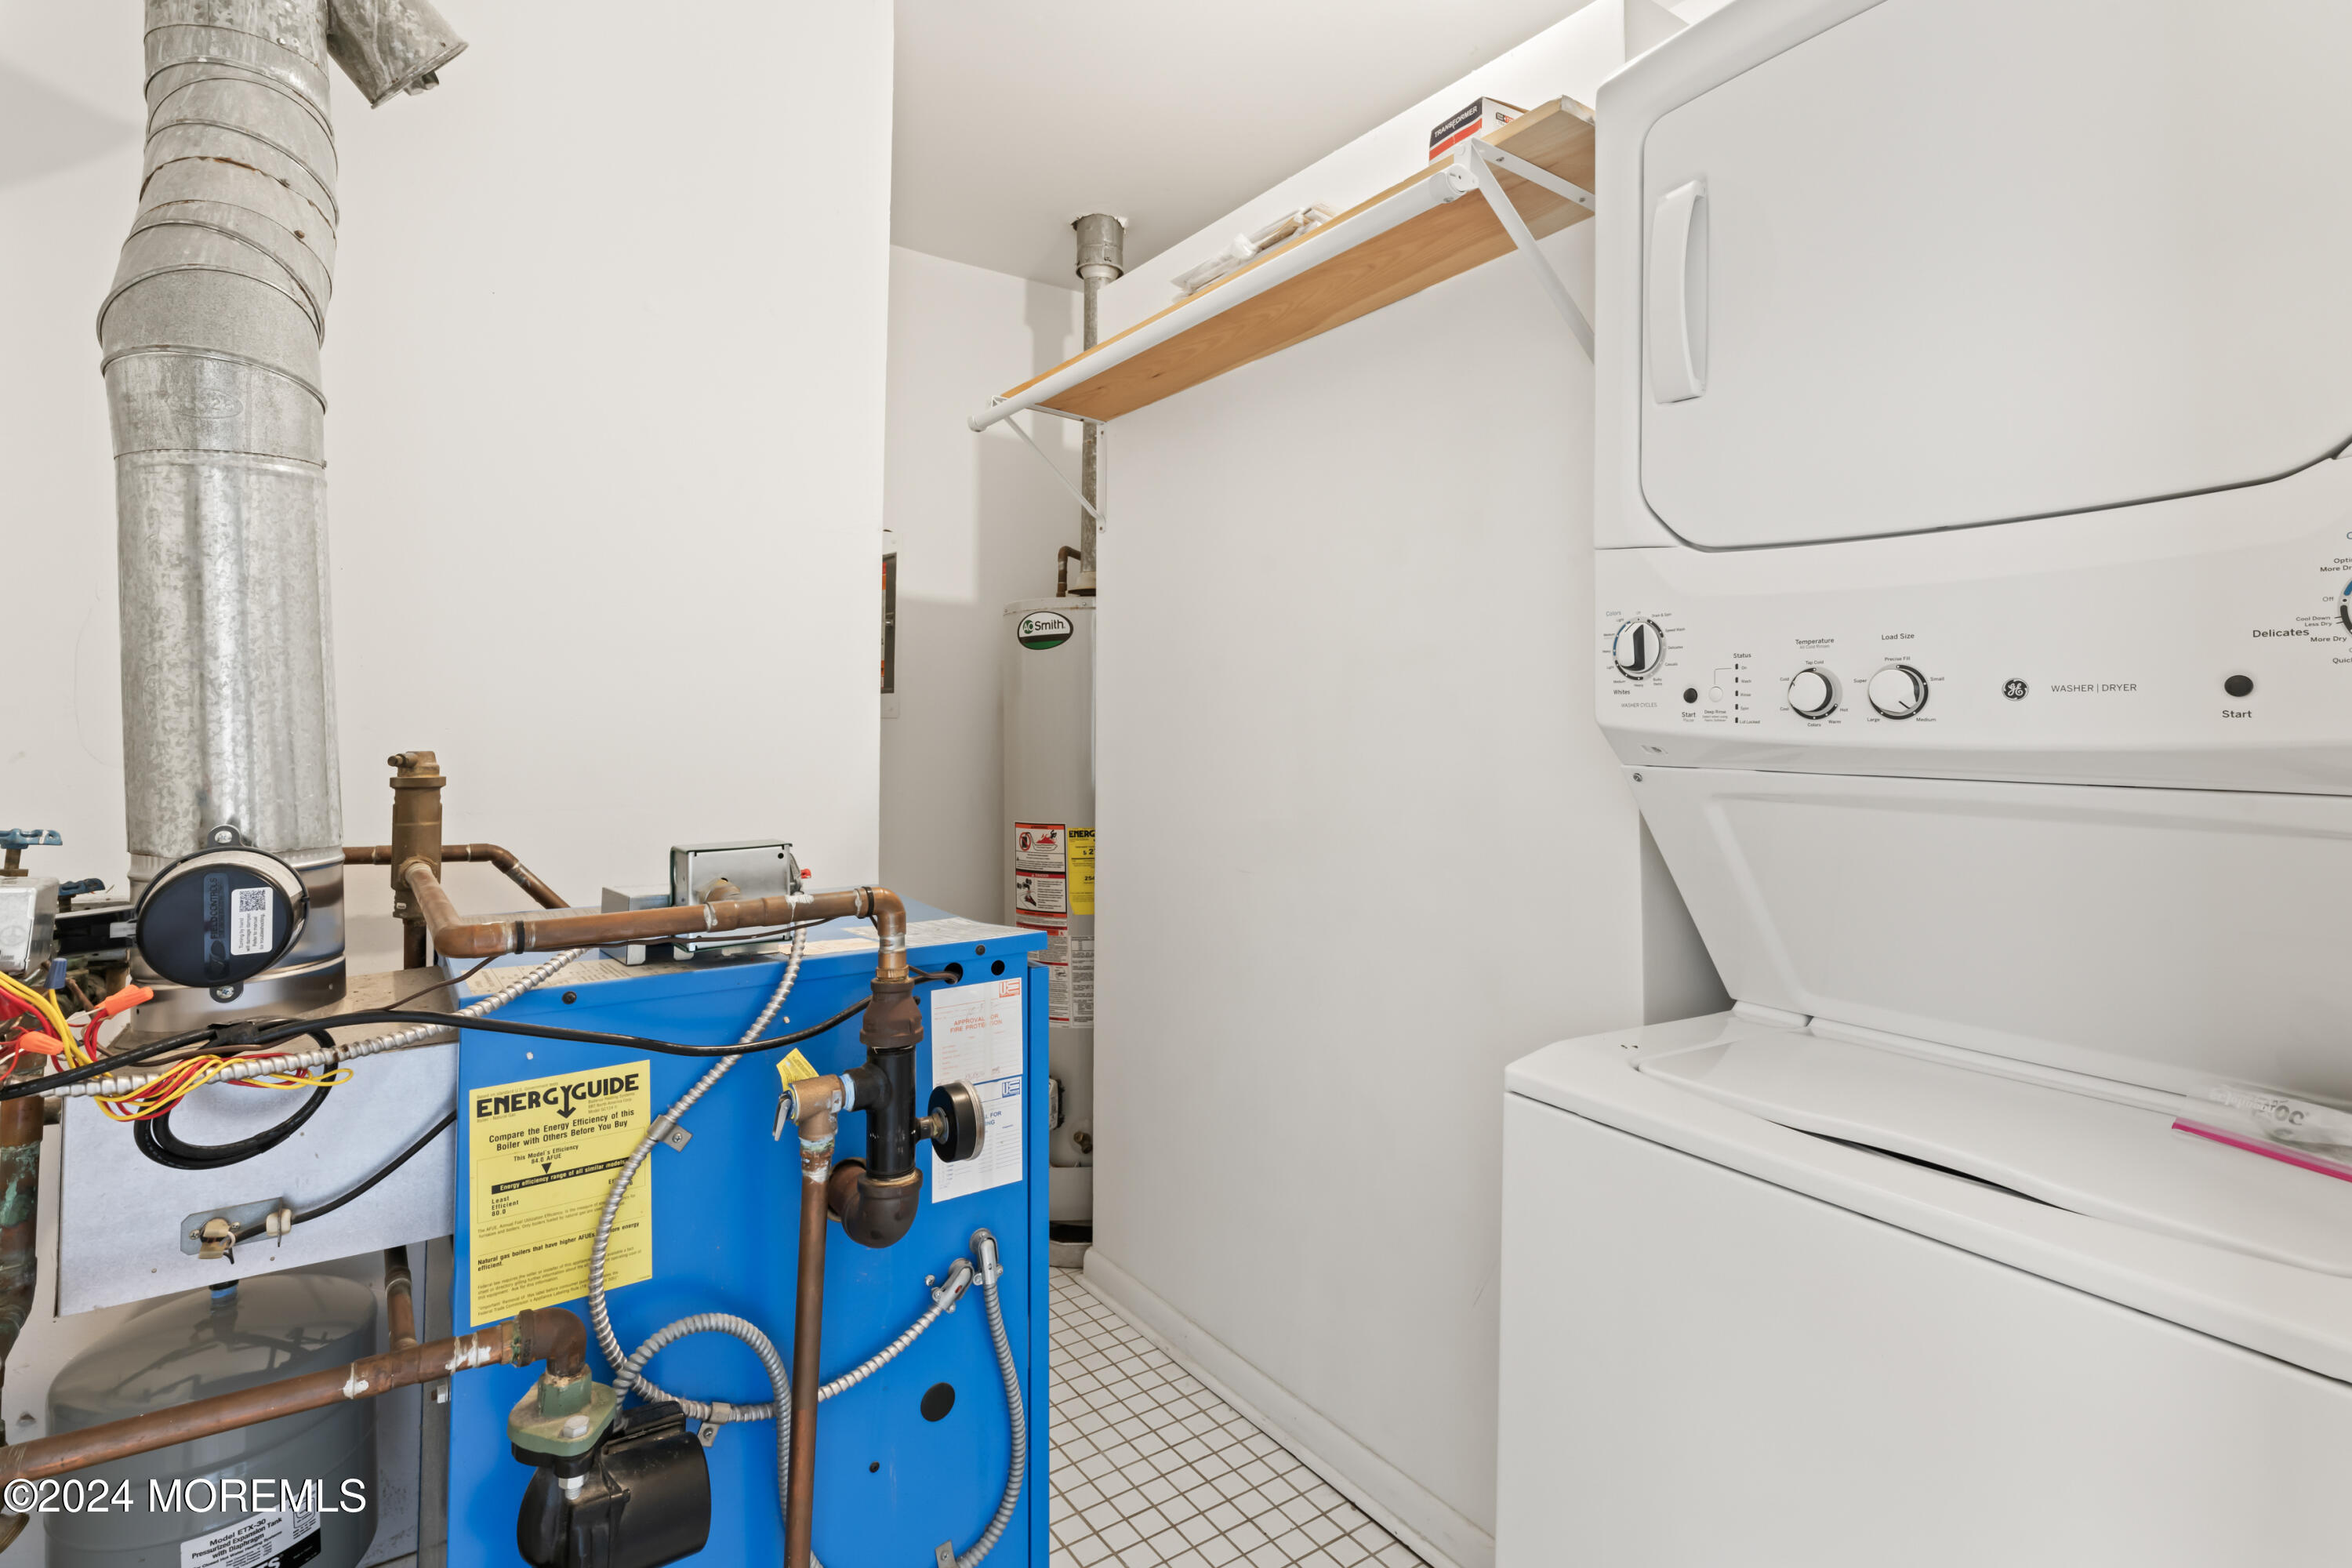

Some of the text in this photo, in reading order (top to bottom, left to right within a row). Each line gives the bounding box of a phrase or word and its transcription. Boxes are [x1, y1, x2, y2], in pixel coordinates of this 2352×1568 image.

[1434, 105, 1478, 138] TRANSFORMER
[1034, 619, 1064, 631] Smith
[2252, 628, 2310, 638] Delicates
[2051, 683, 2137, 693] WASHER DRYER
[2222, 710, 2252, 719] Start
[1069, 829, 1095, 838] ENERG
[950, 1021, 1003, 1034] FIRE PROTEION
[953, 1016, 985, 1026] APPROVAL
[477, 1073, 639, 1119] ENERGYGUIDE
[989, 1110, 1002, 1119] FOR
[489, 1129, 524, 1144] Compare
[528, 1126, 539, 1135] the
[543, 1120, 568, 1133] Energy
[572, 1113, 608, 1127] Efficiency
[622, 1108, 633, 1117] this
[496, 1119, 627, 1151] Boiler with Others Before You Buy
[552, 1143, 578, 1155] Efficiency
[500, 1181, 519, 1192] Energy
[521, 1175, 548, 1187] efficiency
[550, 1171, 566, 1181] range
[585, 1163, 604, 1172] similar
[606, 1159, 625, 1168] models
[492, 1200, 518, 1210] Efficient
[477, 1255, 497, 1265] Natural
[512, 1247, 530, 1256] boilers
[559, 1236, 575, 1246] higher
[622, 1221, 639, 1230] energy
[191, 1541, 231, 1559] Pressurized
[232, 1526, 266, 1544] Expansion
[267, 1517, 283, 1529] Tank
[209, 1518, 267, 1547] Model ETX-30
[212, 1548, 227, 1559] with
[229, 1533, 264, 1553] Diaphragm
